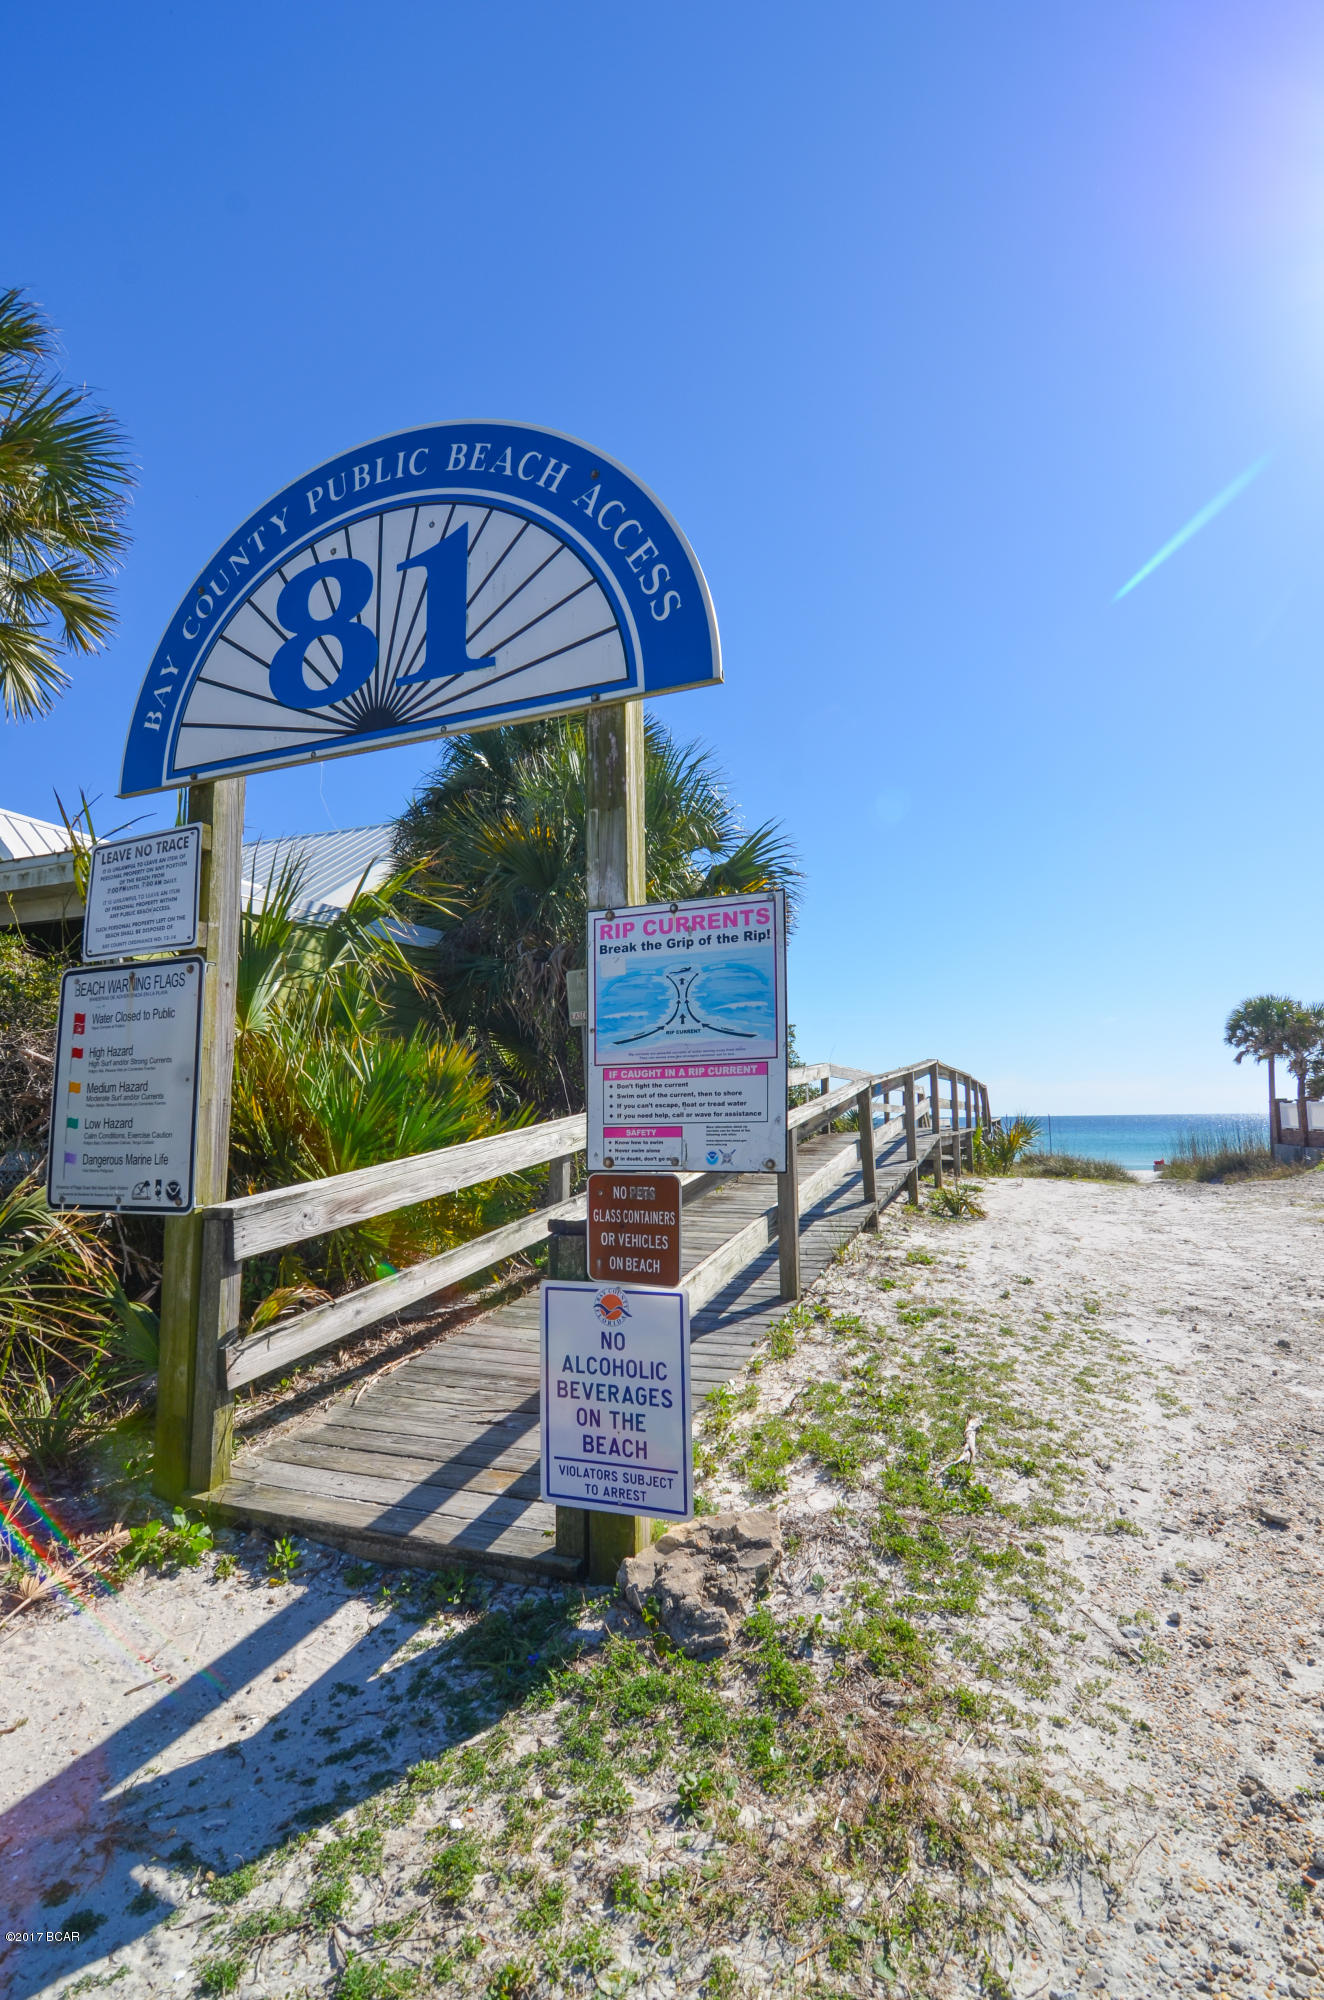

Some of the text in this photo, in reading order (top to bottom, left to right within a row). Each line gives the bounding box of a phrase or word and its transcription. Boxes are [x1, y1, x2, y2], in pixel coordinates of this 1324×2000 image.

[143, 442, 683, 732] BAY COUNTY PUBLIC BEACH ACCESS
[268, 520, 496, 709] 81
[101, 836, 189, 865] LEAVE NO TRACE
[600, 907, 770, 941] RIP CURRENTS
[600, 929, 771, 955] Break the Grip of the Rip!
[75, 972, 186, 997] BEACH WARNING FLAGS
[92, 1007, 176, 1024] Water Closed to Public
[89, 1044, 134, 1060] High Hazard
[101, 1059, 112, 1067] Surf
[130, 1058, 148, 1066] Strong
[609, 1065, 758, 1079] IF CAUGHT IN A RIP CURRENT
[87, 1080, 149, 1094] Medium Hazard
[635, 1082, 650, 1090] fight
[655, 1102, 681, 1110] escape,
[84, 1117, 133, 1129] Low Hazard
[655, 1112, 670, 1120] help,
[82, 1153, 168, 1168] Dangerous Marine Life
[613, 1186, 627, 1199] NO
[593, 1209, 676, 1226] GLASS CONTAINERS
[601, 1232, 669, 1249] OR VEHICLES
[609, 1256, 660, 1273] ON BEACH
[601, 1331, 625, 1351] NO
[562, 1354, 667, 1381] ALCOHOLIC
[557, 1380, 673, 1408] BEVERAGES
[576, 1407, 646, 1432] ON THE
[583, 1434, 647, 1460] BEACH
[559, 1464, 674, 1490] VIOLATORS SUBJECT
[585, 1483, 647, 1502] TO ARREST
